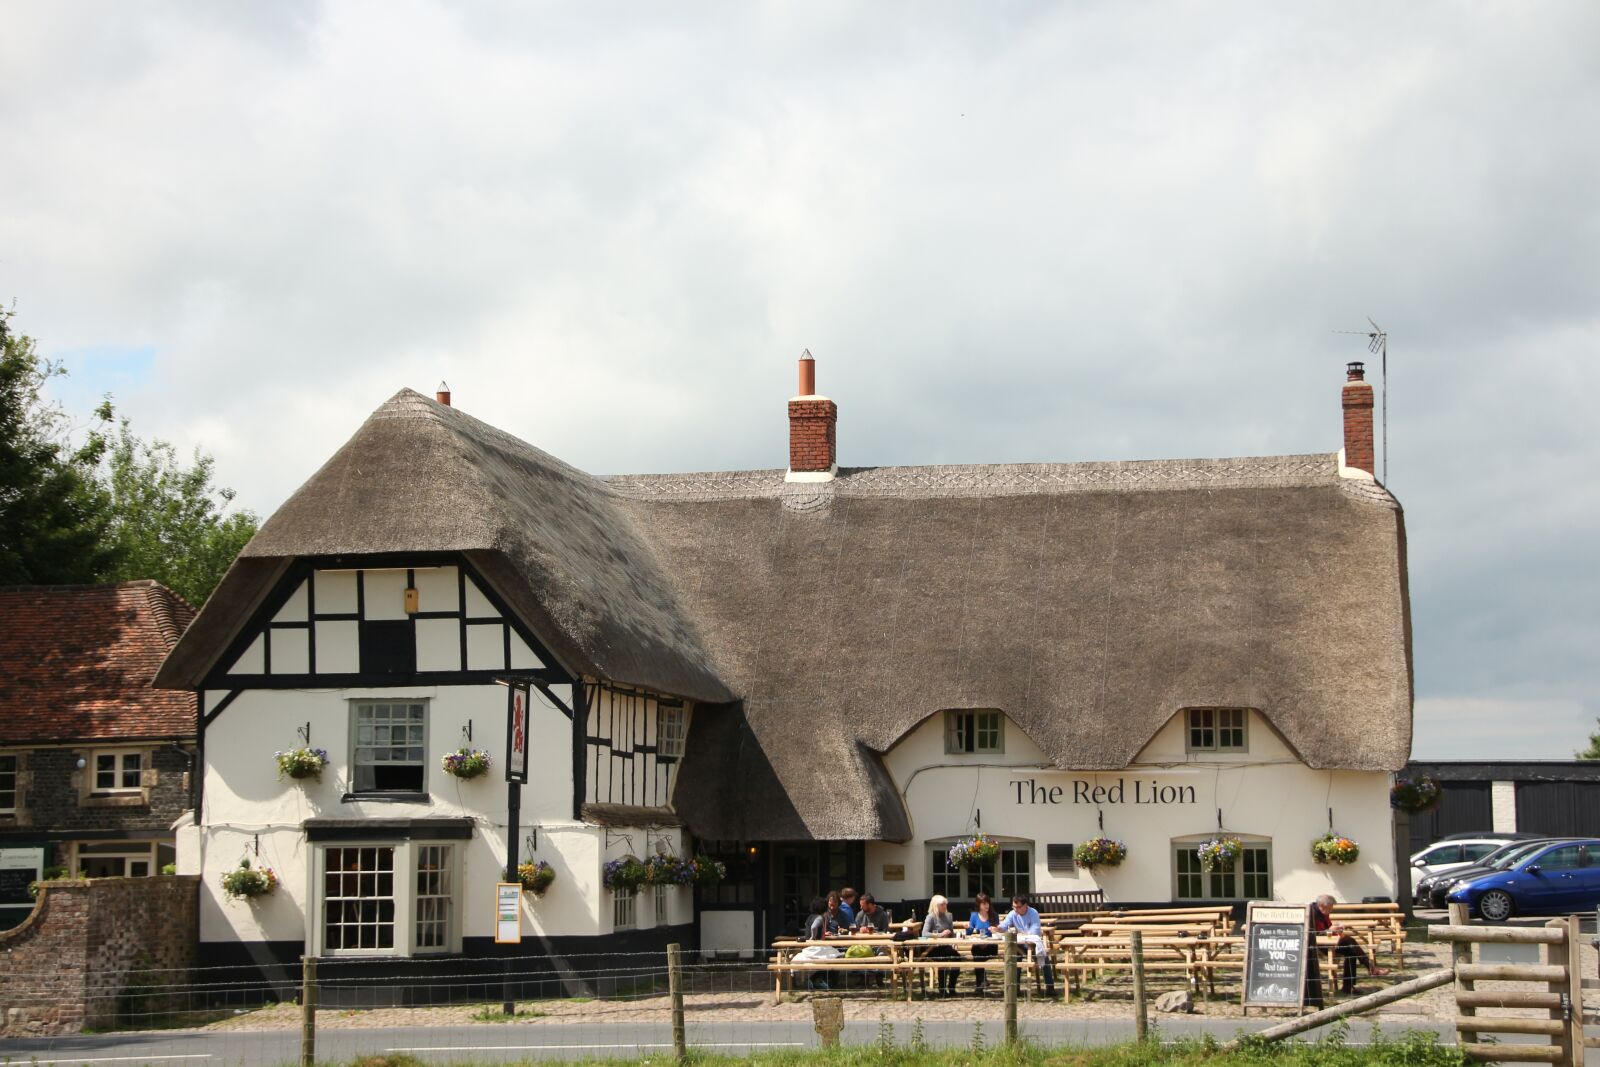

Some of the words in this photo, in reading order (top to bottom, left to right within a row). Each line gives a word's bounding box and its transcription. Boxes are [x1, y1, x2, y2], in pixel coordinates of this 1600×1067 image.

[1010, 779, 1063, 804] The
[1073, 778, 1125, 804] Red
[1134, 780, 1196, 804] Lion
[1258, 938, 1300, 951] WELCOME
[1268, 950, 1286, 960] YOU
